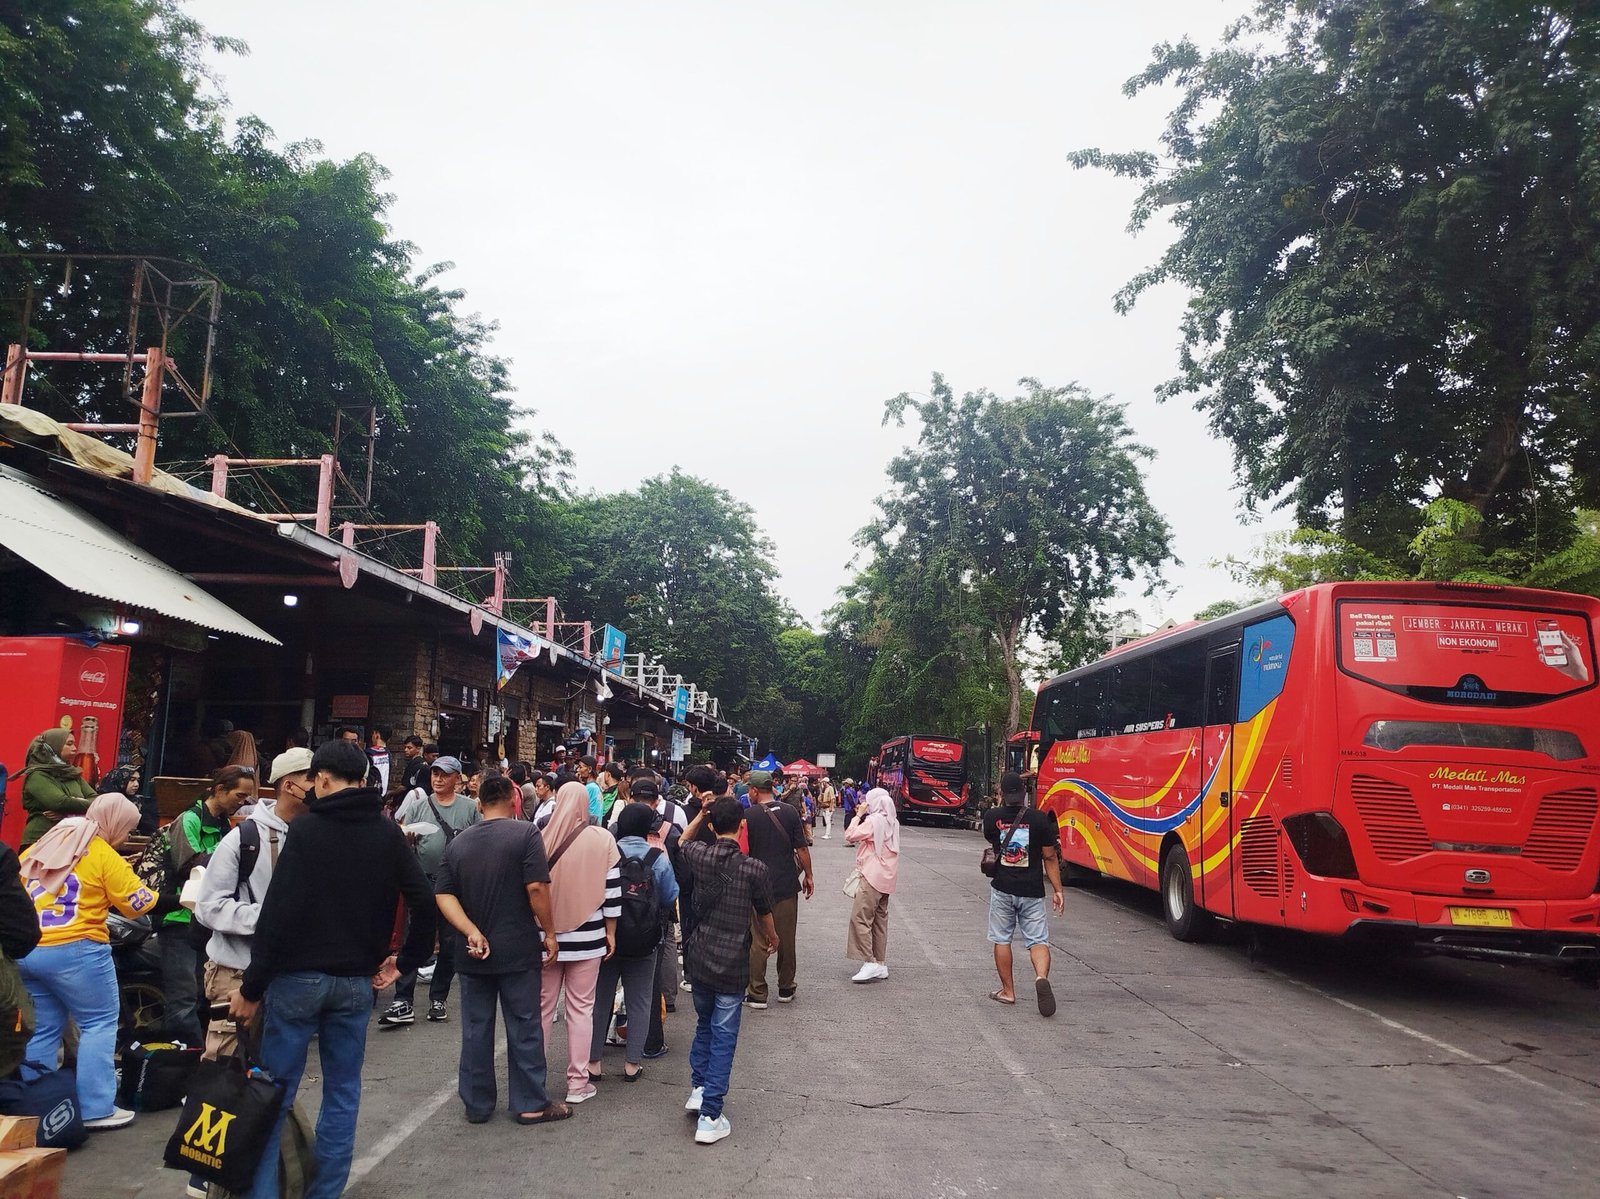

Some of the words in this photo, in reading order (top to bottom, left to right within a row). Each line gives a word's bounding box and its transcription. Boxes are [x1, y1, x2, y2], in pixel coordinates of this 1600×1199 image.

[1408, 618, 1440, 629] JEMBER
[1450, 620, 1486, 631] JAKARTA
[1495, 622, 1523, 633] MERAK
[1439, 638, 1458, 646] NON
[1459, 638, 1498, 648] EKONOMI
[1446, 690, 1497, 700] MORODADI
[60, 696, 92, 708] Segarnya
[92, 701, 118, 710] mantap
[1124, 724, 1134, 733] AIR
[1428, 766, 1488, 782] Medali
[1490, 770, 1526, 784] Mas
[128, 888, 154, 912] 23
[180, 1144, 222, 1170] MOBATIC
